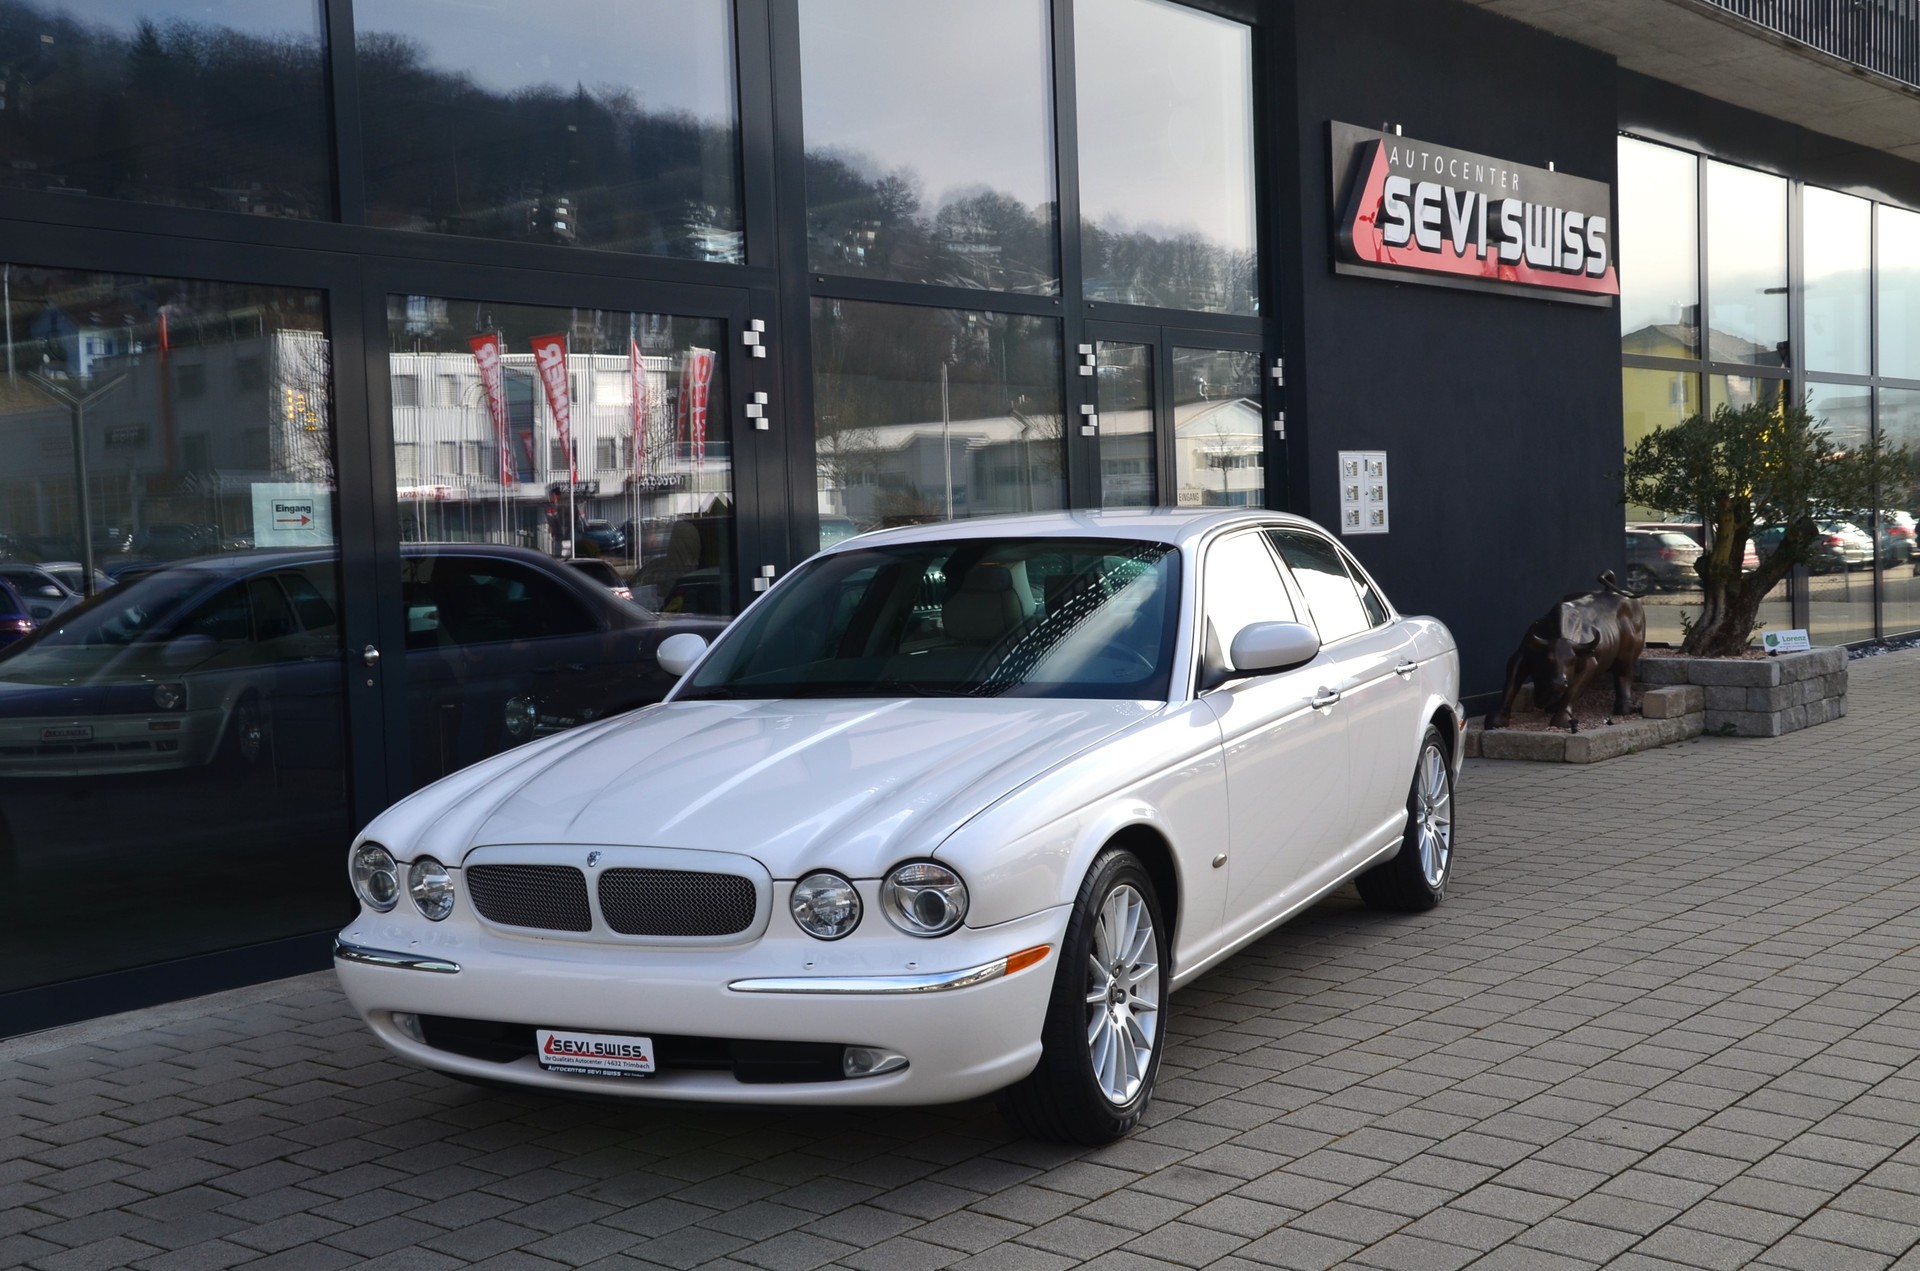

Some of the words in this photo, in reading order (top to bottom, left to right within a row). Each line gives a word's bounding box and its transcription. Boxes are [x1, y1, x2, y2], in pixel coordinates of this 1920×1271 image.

[1390, 146, 1520, 191] AUTOCENTER
[1383, 175, 1487, 257] SEVI
[1501, 198, 1606, 275] SWISS
[1179, 492, 1199, 502] EINGANG
[275, 504, 311, 514] Eingang
[553, 1039, 590, 1054] SEVI
[594, 1042, 642, 1058] SWISS
[575, 1057, 602, 1065] Autocenter
[623, 1061, 650, 1069] Trimbach
